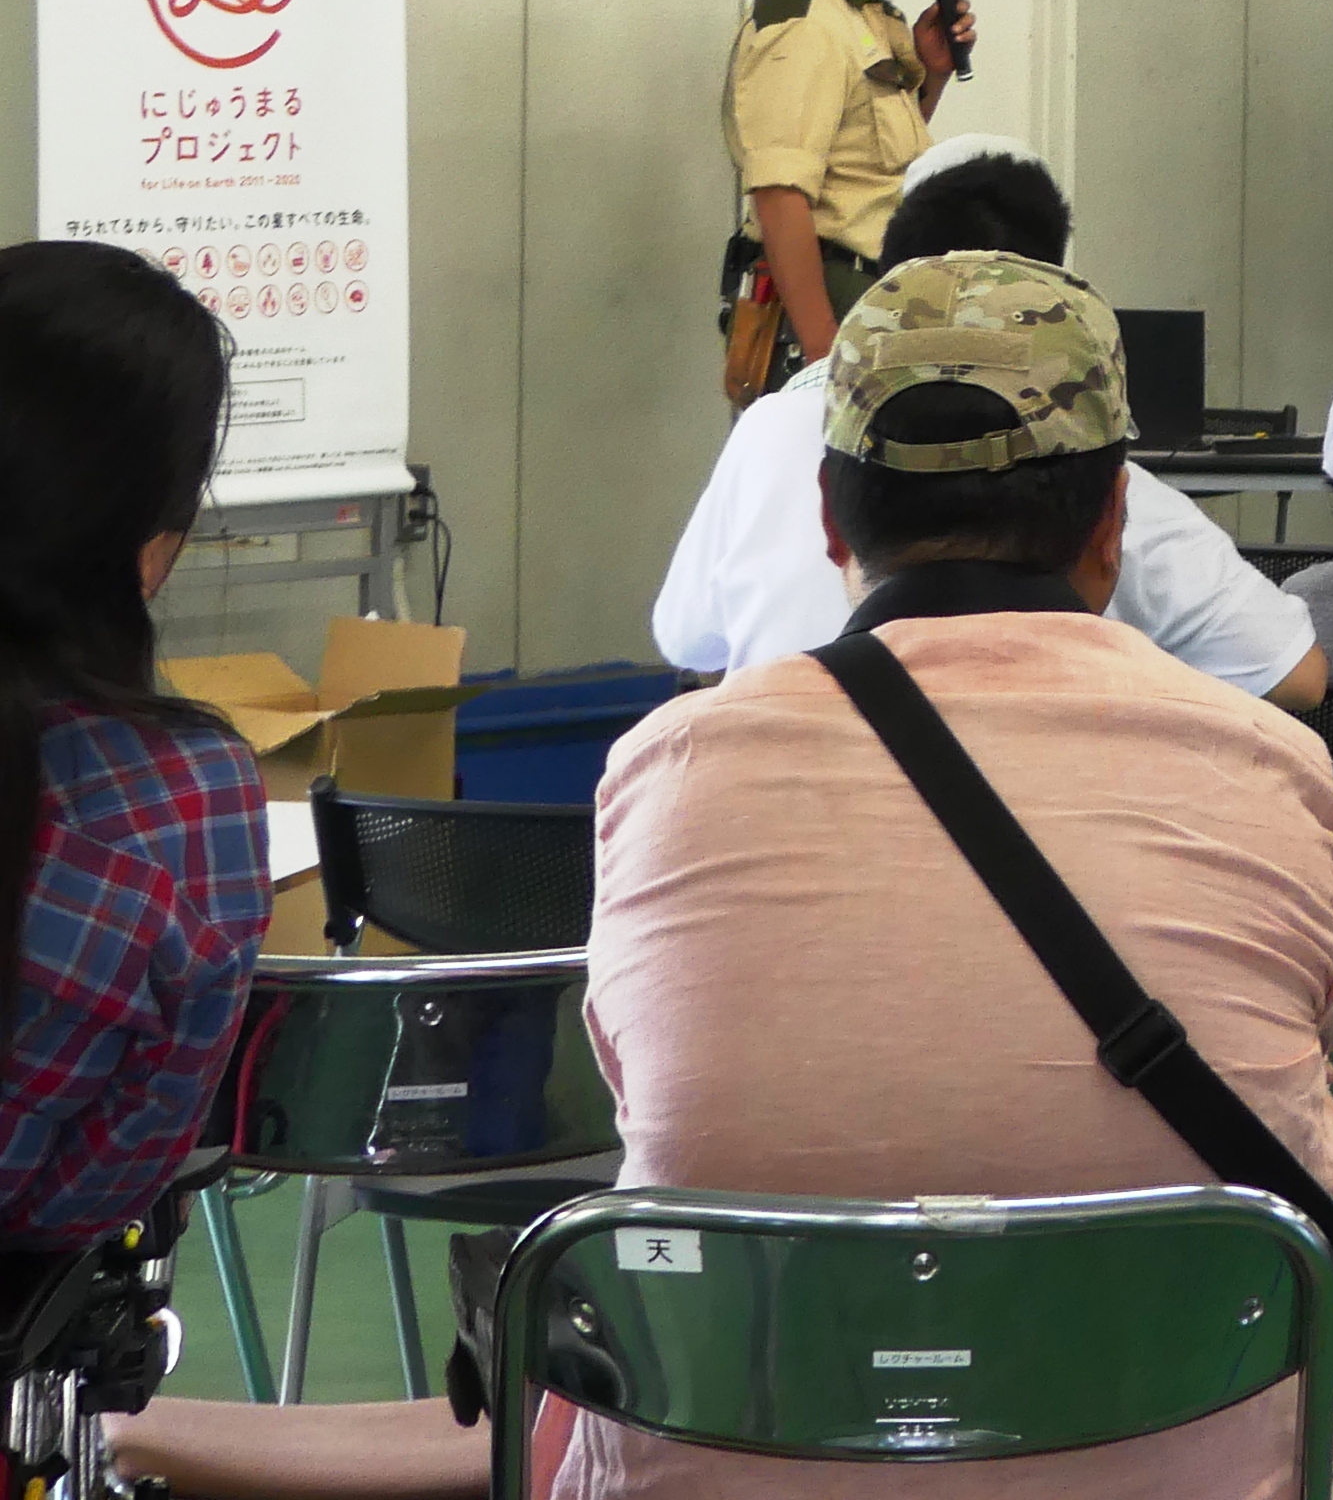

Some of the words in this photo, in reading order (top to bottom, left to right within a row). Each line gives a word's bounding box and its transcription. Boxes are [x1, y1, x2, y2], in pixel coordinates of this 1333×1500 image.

[141, 86, 302, 119] にじゅうまる
[141, 126, 302, 164] プロジェクト
[162, 176, 184, 190] Life
[206, 176, 235, 189] Earth
[646, 1239, 673, 1263] 天
